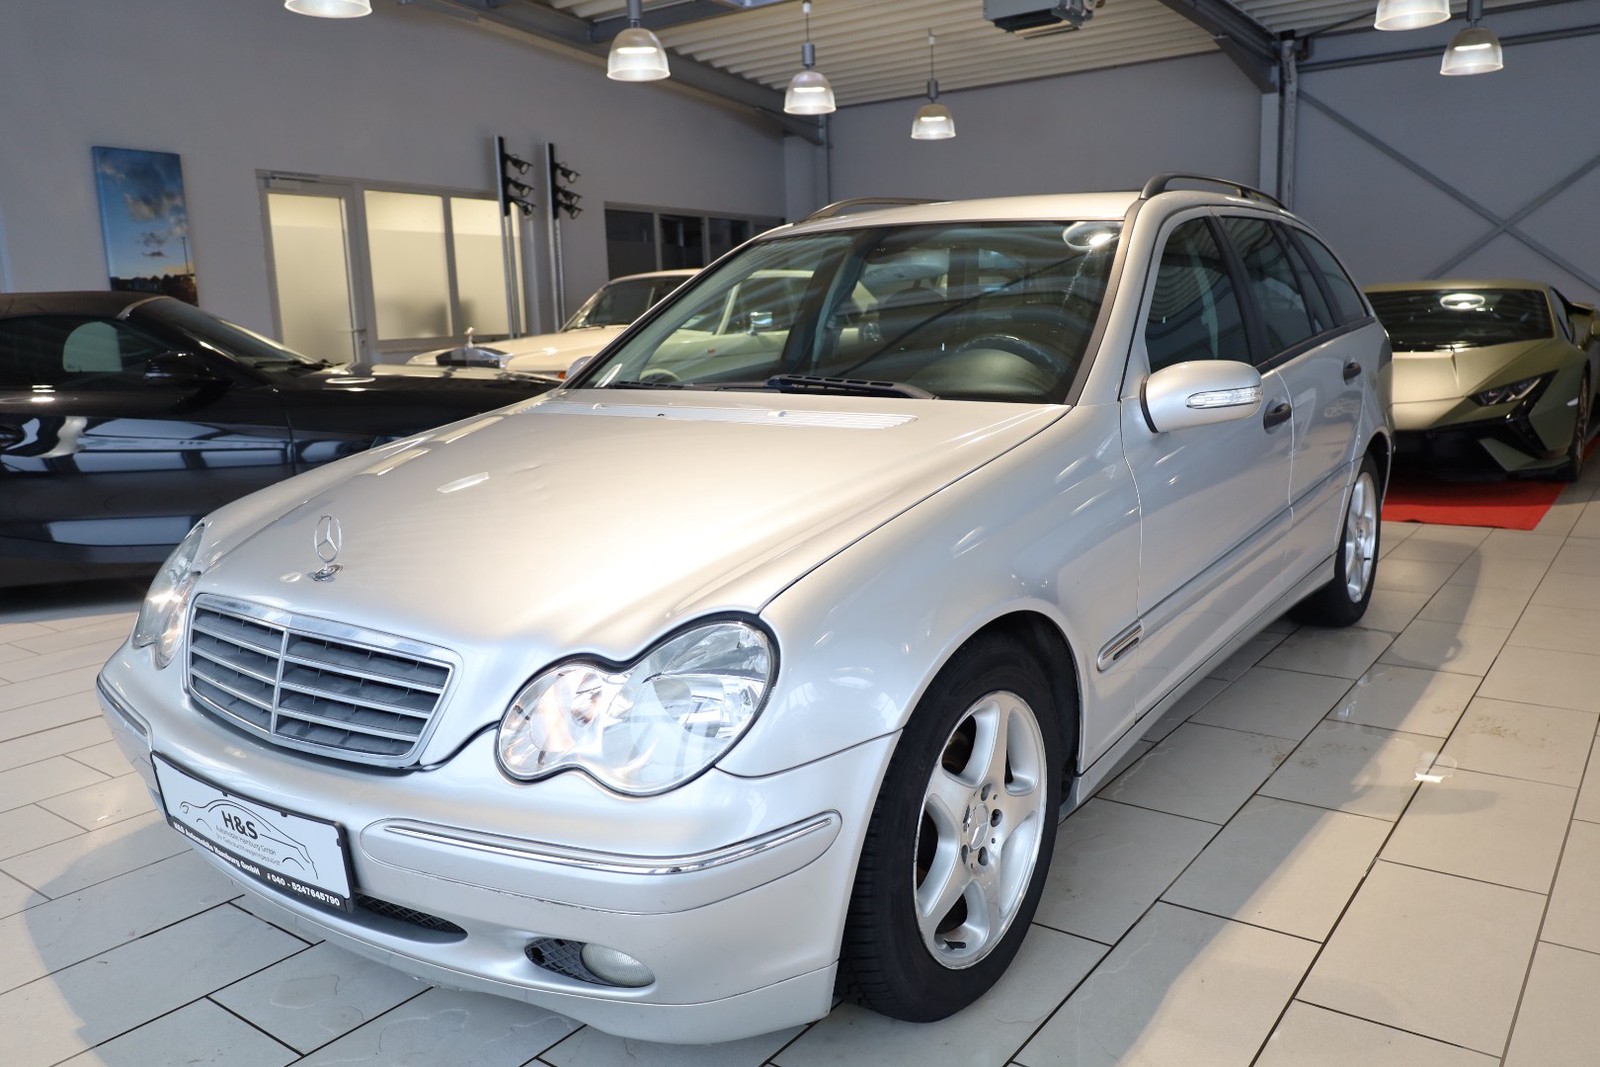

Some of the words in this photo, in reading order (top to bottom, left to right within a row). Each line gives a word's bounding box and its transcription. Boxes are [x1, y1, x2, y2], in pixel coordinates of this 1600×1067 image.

[221, 810, 259, 840] H&S
[213, 845, 241, 868] Hamburg
[272, 874, 286, 886] 040
[291, 882, 341, 906] 5247645790
